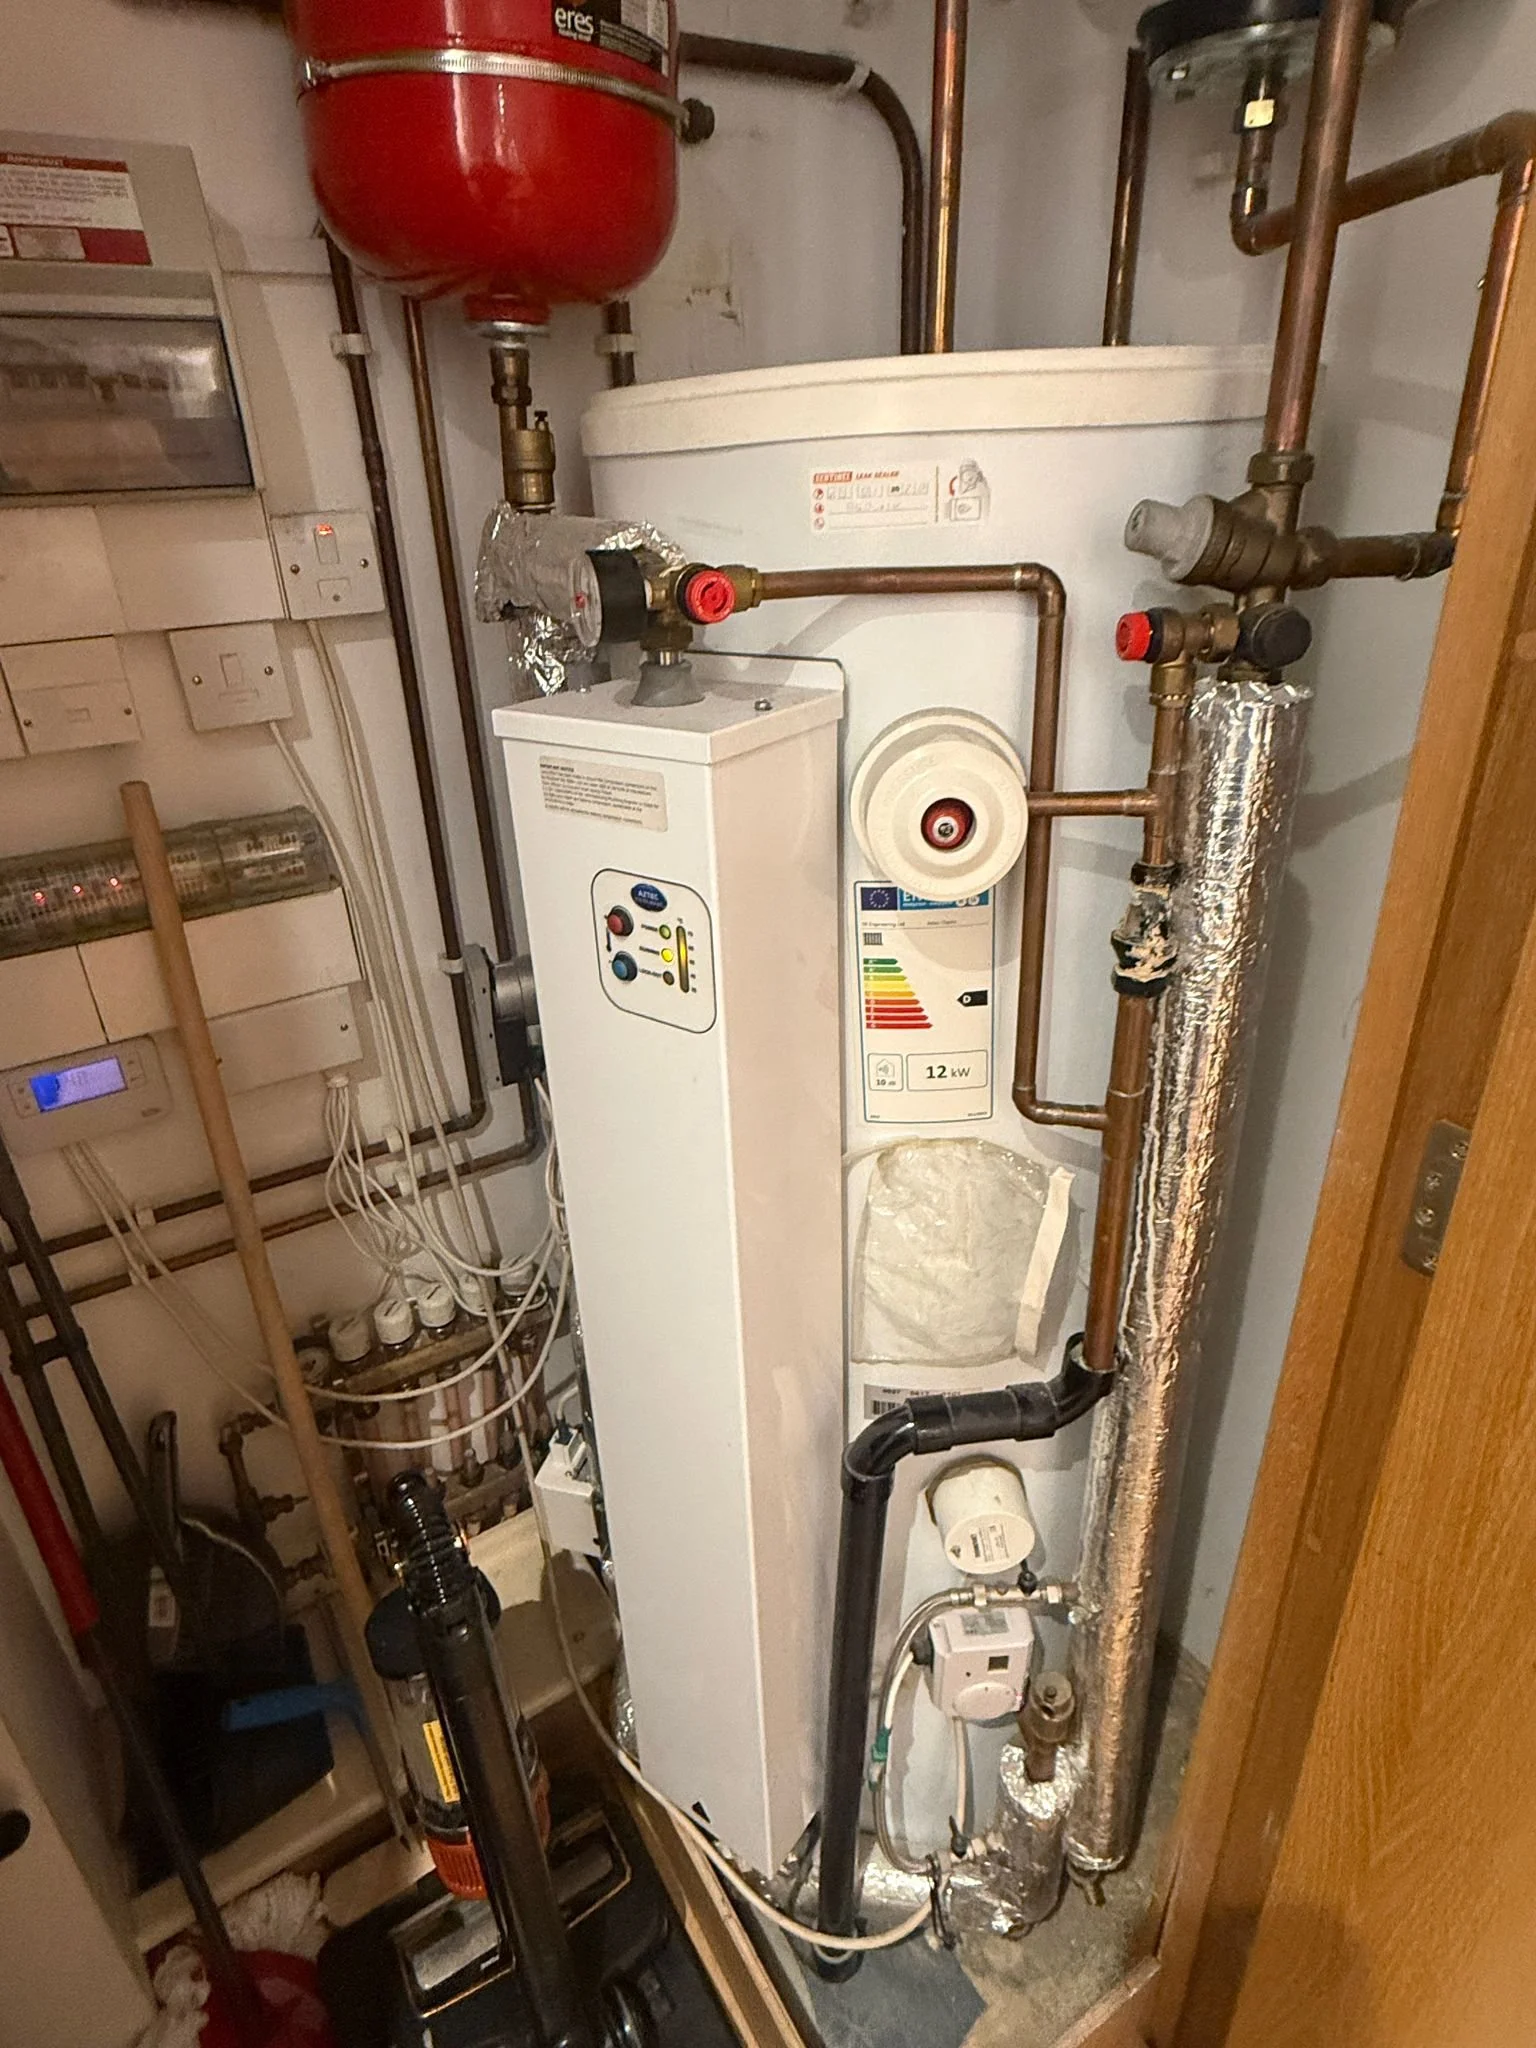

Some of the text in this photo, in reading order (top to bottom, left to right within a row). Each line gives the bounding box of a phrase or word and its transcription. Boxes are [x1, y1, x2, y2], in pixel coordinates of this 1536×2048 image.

[926, 1065, 971, 1080] 12 kW
[876, 1079, 887, 1087] 10
